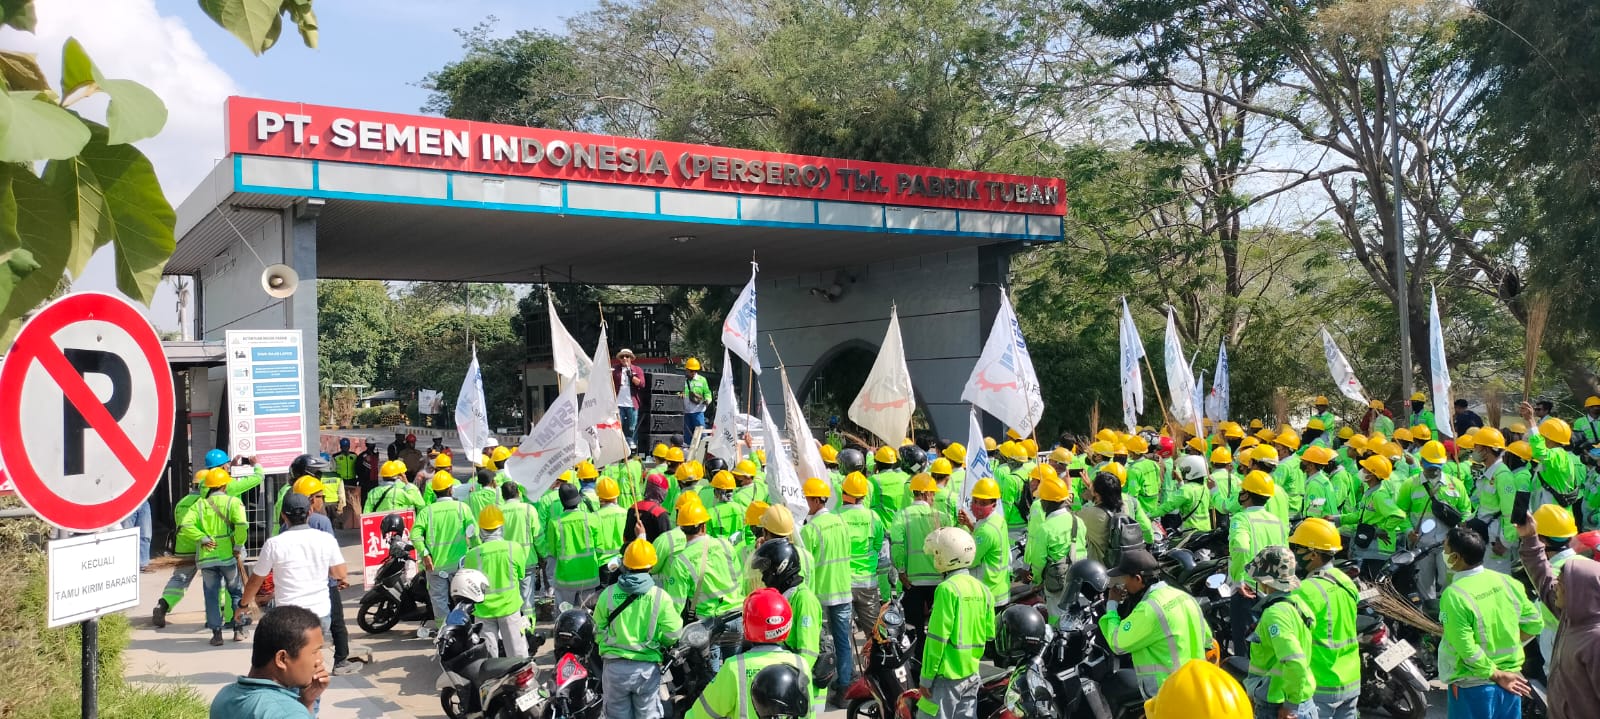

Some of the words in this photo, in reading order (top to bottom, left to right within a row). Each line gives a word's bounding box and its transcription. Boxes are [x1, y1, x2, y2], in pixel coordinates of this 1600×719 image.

[257, 110, 320, 145] PT.
[331, 117, 470, 158] SEMEN
[481, 132, 671, 176] INDONESIA
[678, 151, 832, 191] (PERSERO)
[836, 167, 890, 194] Tbk.
[896, 172, 981, 200] PABRIK
[984, 179, 1059, 206] TUBAN
[63, 347, 132, 476] P
[55, 587, 80, 601] TAMU
[82, 581, 104, 596] KIRIM
[105, 574, 137, 590] BARANG
[81, 555, 115, 571] KECUALI
